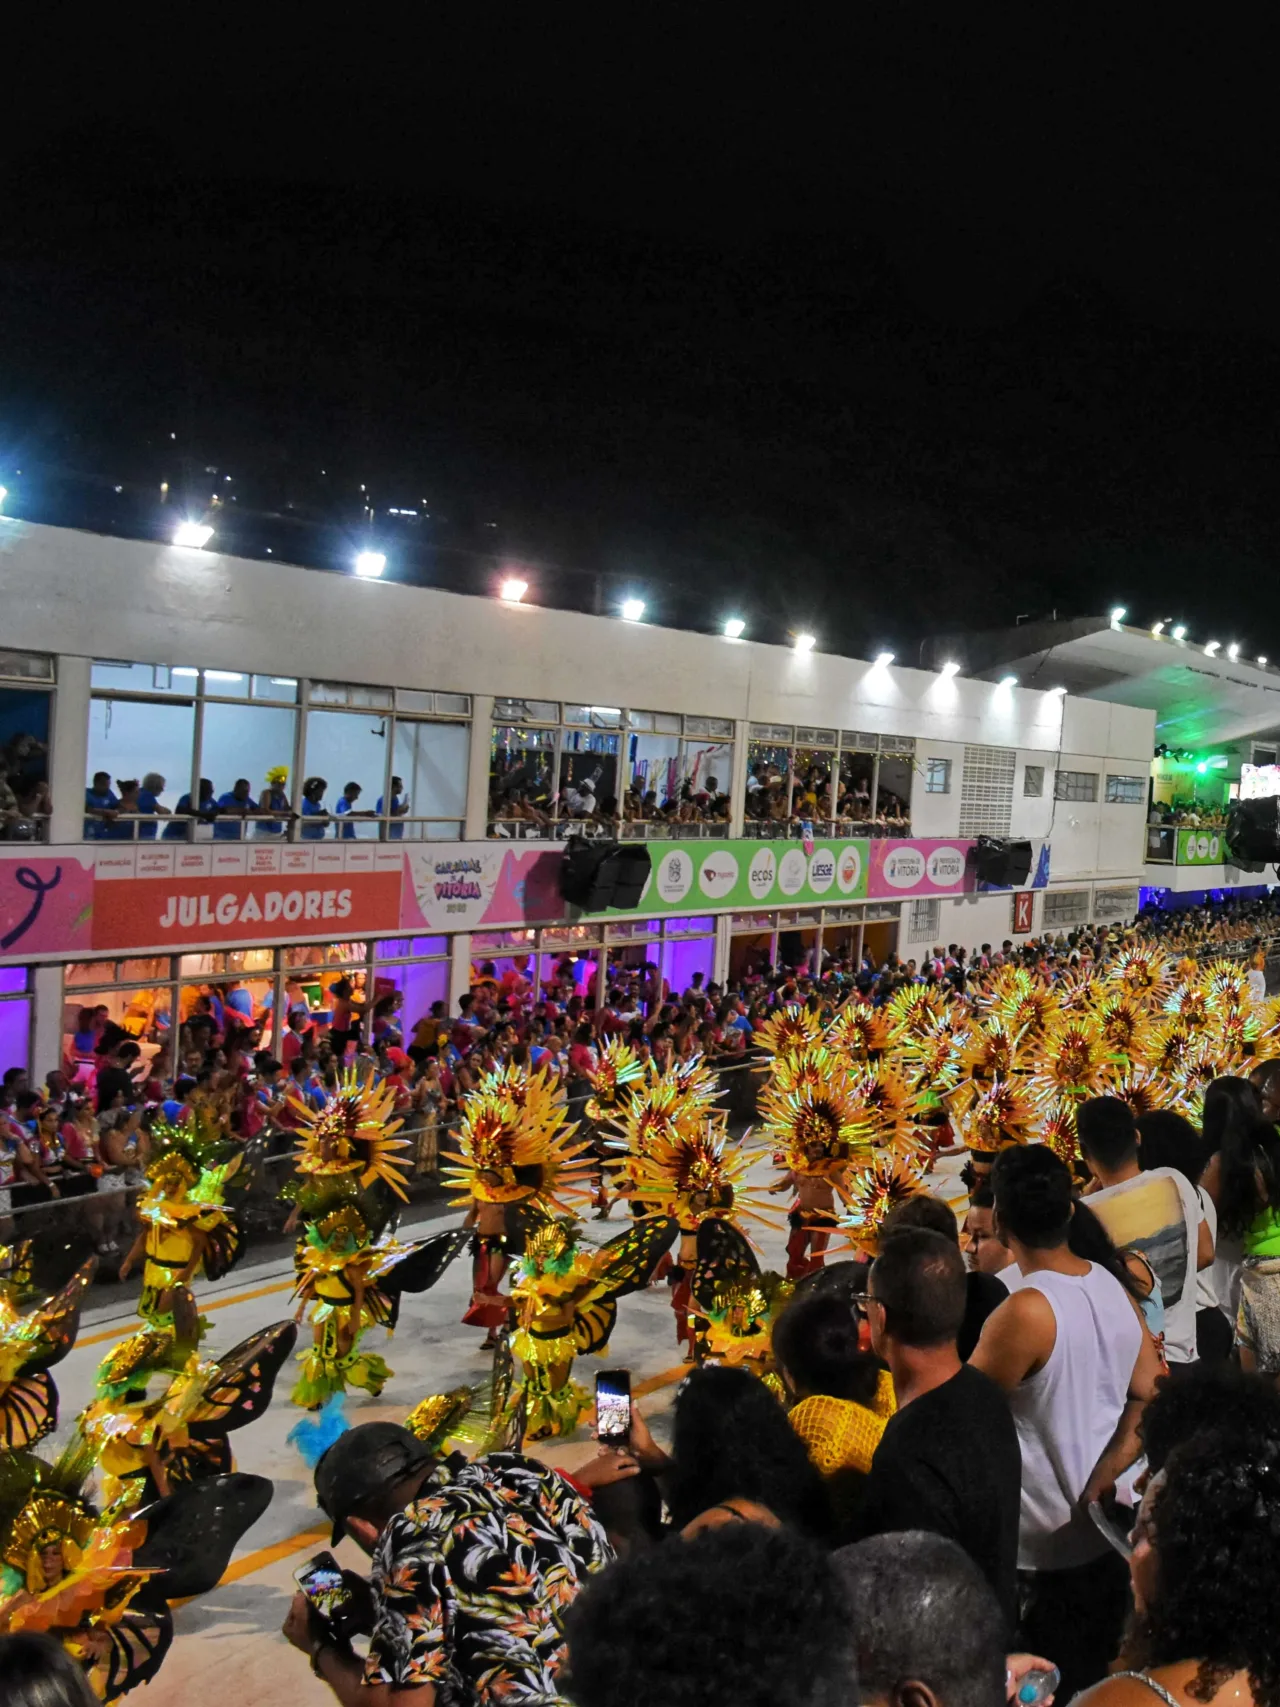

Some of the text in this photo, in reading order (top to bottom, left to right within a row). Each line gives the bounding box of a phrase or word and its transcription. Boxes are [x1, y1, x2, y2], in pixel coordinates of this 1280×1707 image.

[752, 869, 773, 882] ecos
[159, 888, 353, 928] JULGADORES
[1018, 900, 1029, 926] K
